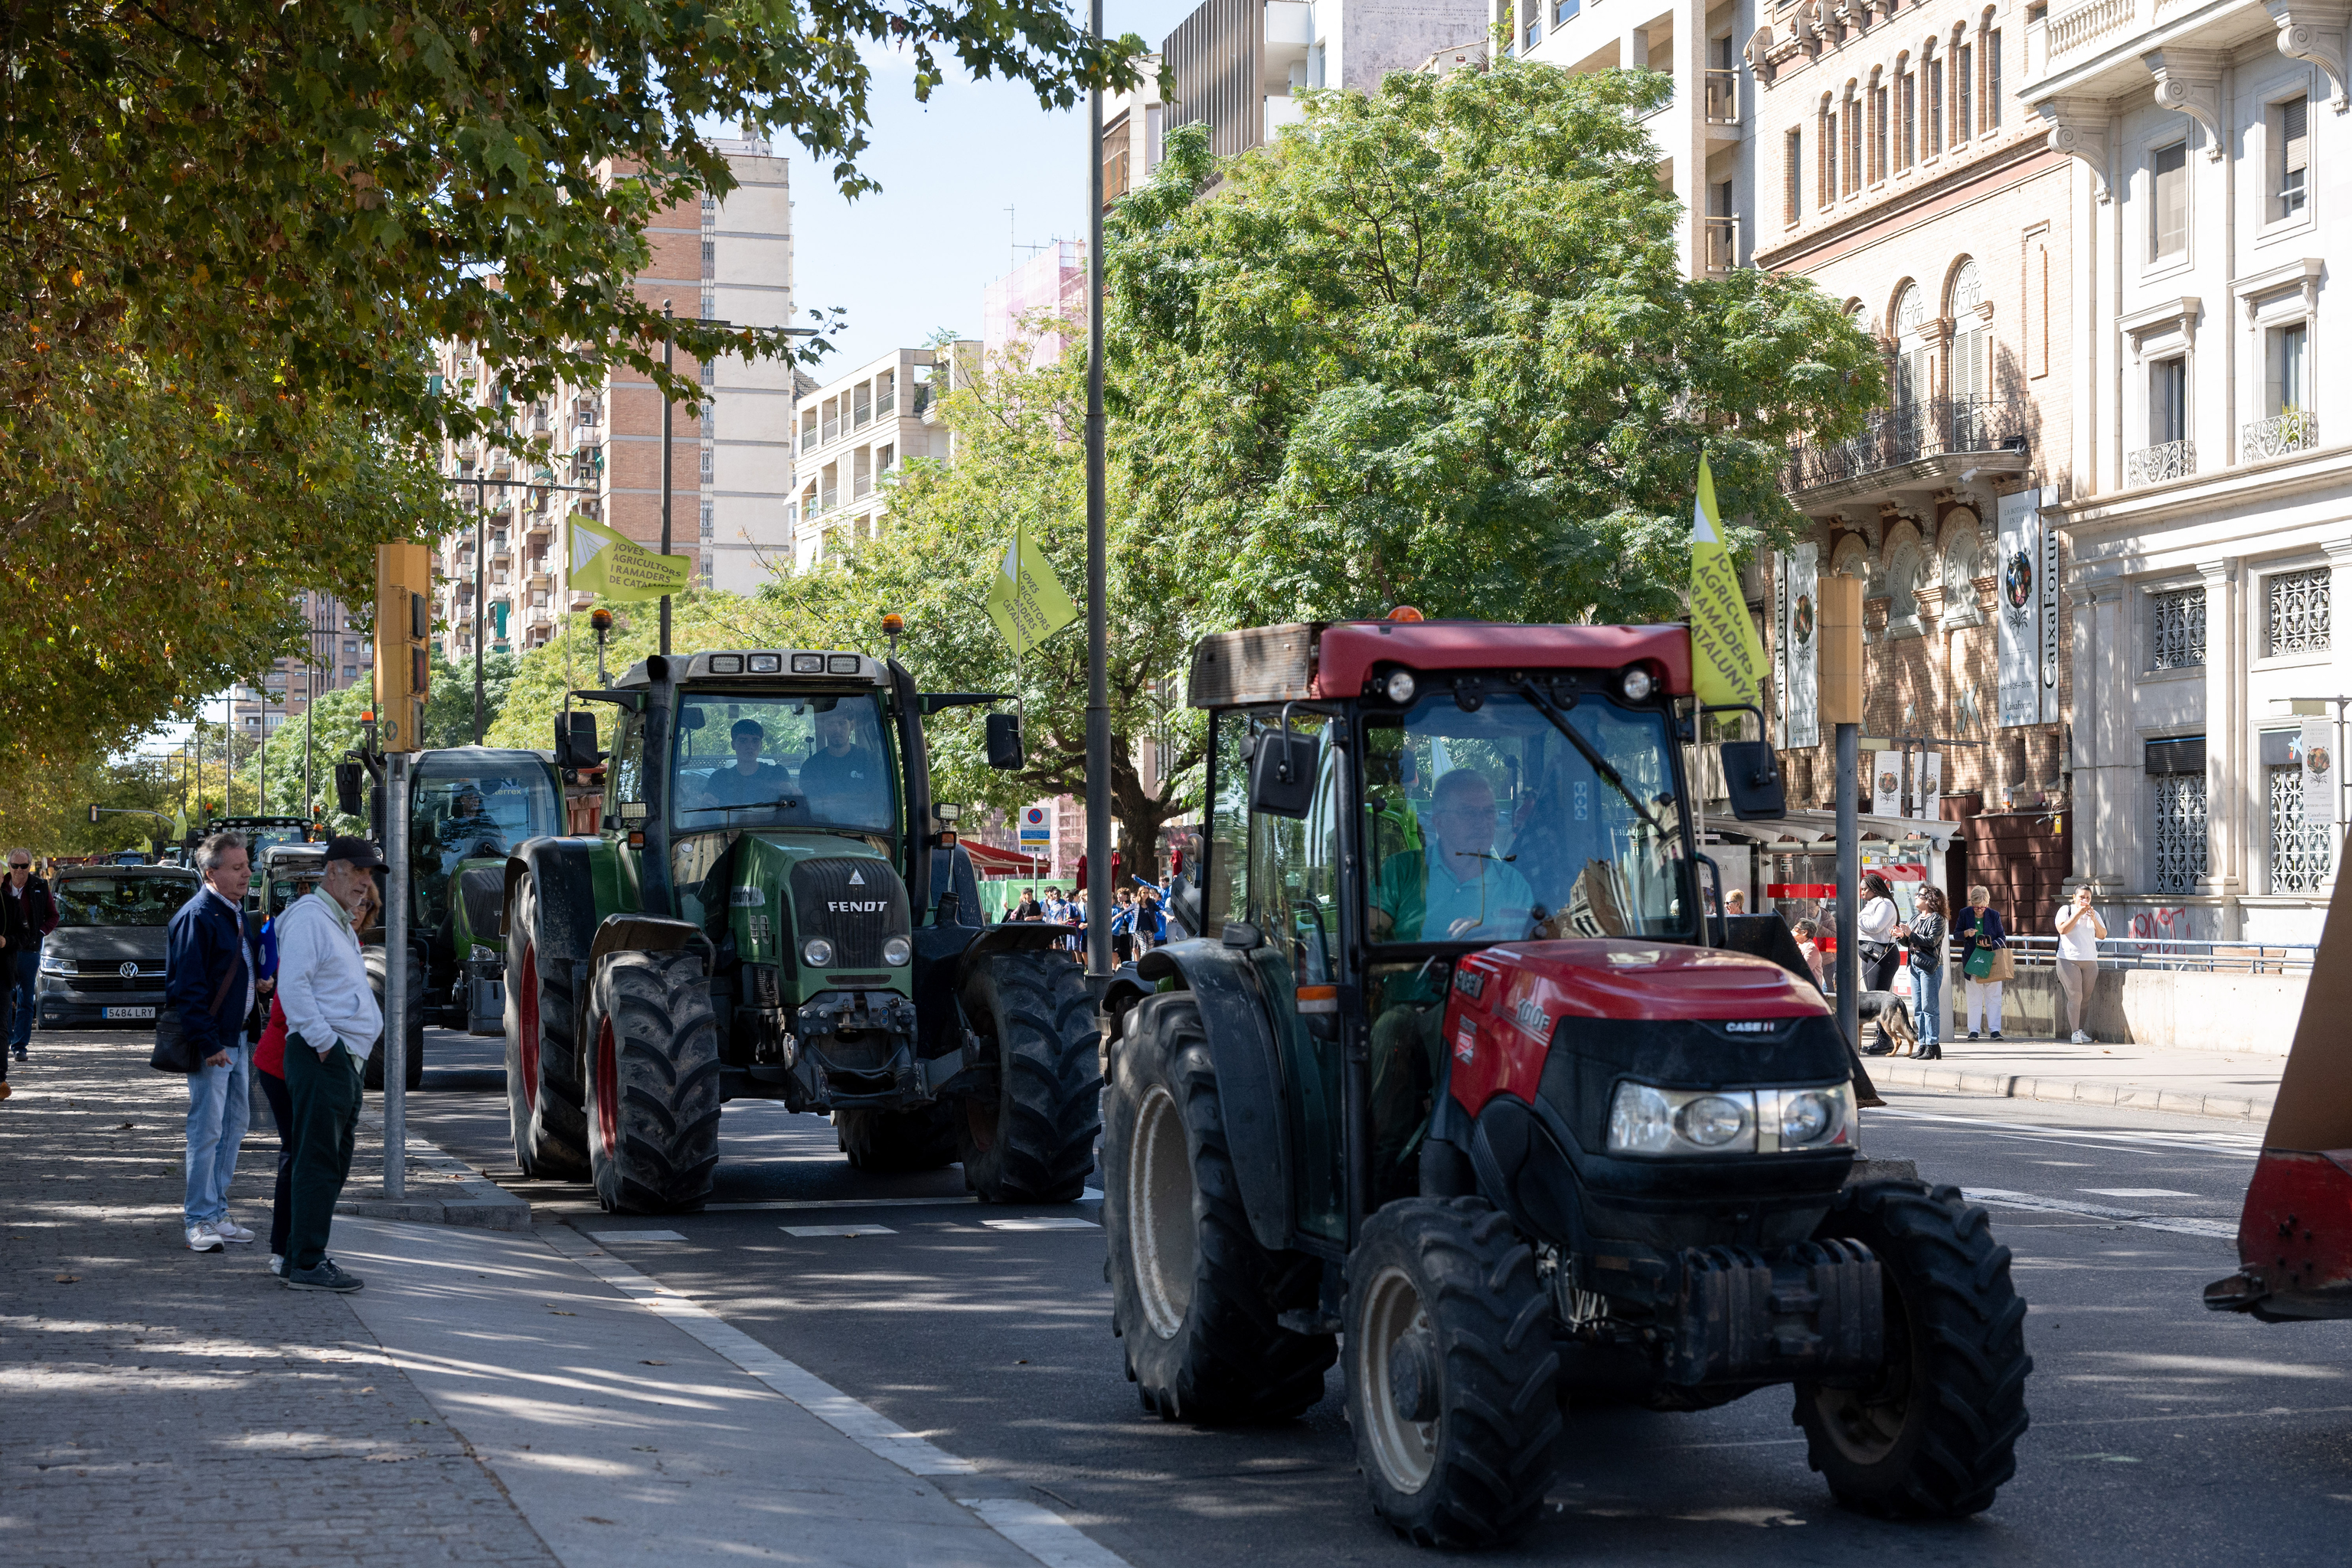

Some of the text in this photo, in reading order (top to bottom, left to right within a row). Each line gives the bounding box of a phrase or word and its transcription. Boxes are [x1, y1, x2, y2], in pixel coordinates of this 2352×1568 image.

[613, 543, 645, 556] JOVES
[612, 554, 681, 577] AGRICULTORS
[609, 575, 622, 585] DE
[616, 565, 671, 583] RAMADERS
[1775, 577, 1785, 721] CaixaForum
[2005, 700, 2033, 711] CaixaForum
[827, 901, 888, 912] FENDT
[109, 1008, 153, 1018] 5484 LRY
[1516, 998, 1551, 1032] 100F
[1725, 1021, 1762, 1032] CASE
